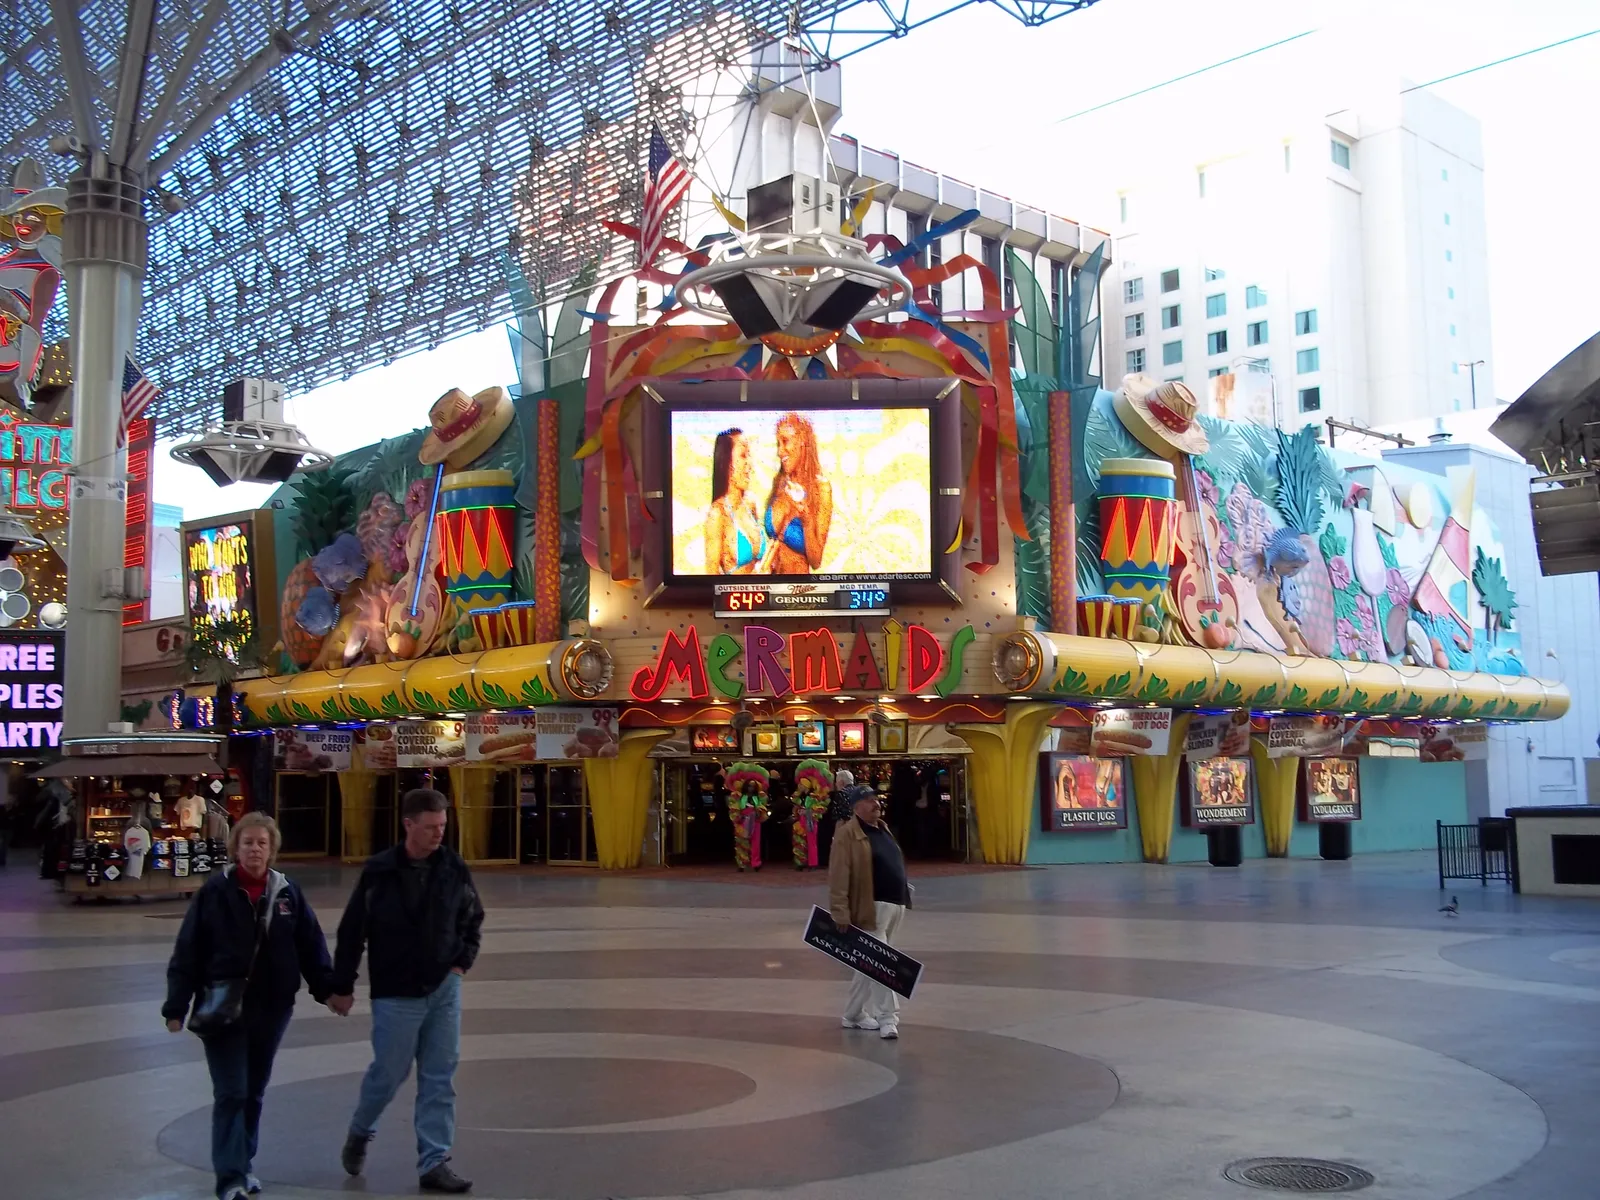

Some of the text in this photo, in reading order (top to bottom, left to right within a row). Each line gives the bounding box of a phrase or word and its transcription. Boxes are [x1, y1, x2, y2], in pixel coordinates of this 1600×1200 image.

[856, 572, 931, 580] www.adartesc.com
[787, 584, 818, 596] Miller
[775, 596, 829, 604] GENUINE
[468, 714, 519, 726] ALL-AMERICAN
[537, 713, 584, 723] DEEP FRIED
[1114, 711, 1170, 722] ALL-AMERICAN
[467, 725, 500, 735] HOT DOG
[537, 724, 576, 734] TWINKIES
[1150, 720, 1169, 730] DOG
[397, 725, 445, 736] CHOCOLATE
[1270, 730, 1305, 739] COVERED
[306, 733, 351, 744] DEEP FRIED
[397, 735, 436, 745] COVERED
[321, 743, 351, 752] OREO'S
[397, 745, 439, 755] BANANAS
[1196, 807, 1247, 819] WONDERMENT
[1312, 804, 1355, 814] INDULGENCE
[1062, 811, 1116, 822] PLASTIC JUGS
[811, 935, 834, 951] ASK
[834, 946, 858, 964] FOR
[857, 935, 899, 962] SHOWS
[852, 948, 897, 977] DINING
